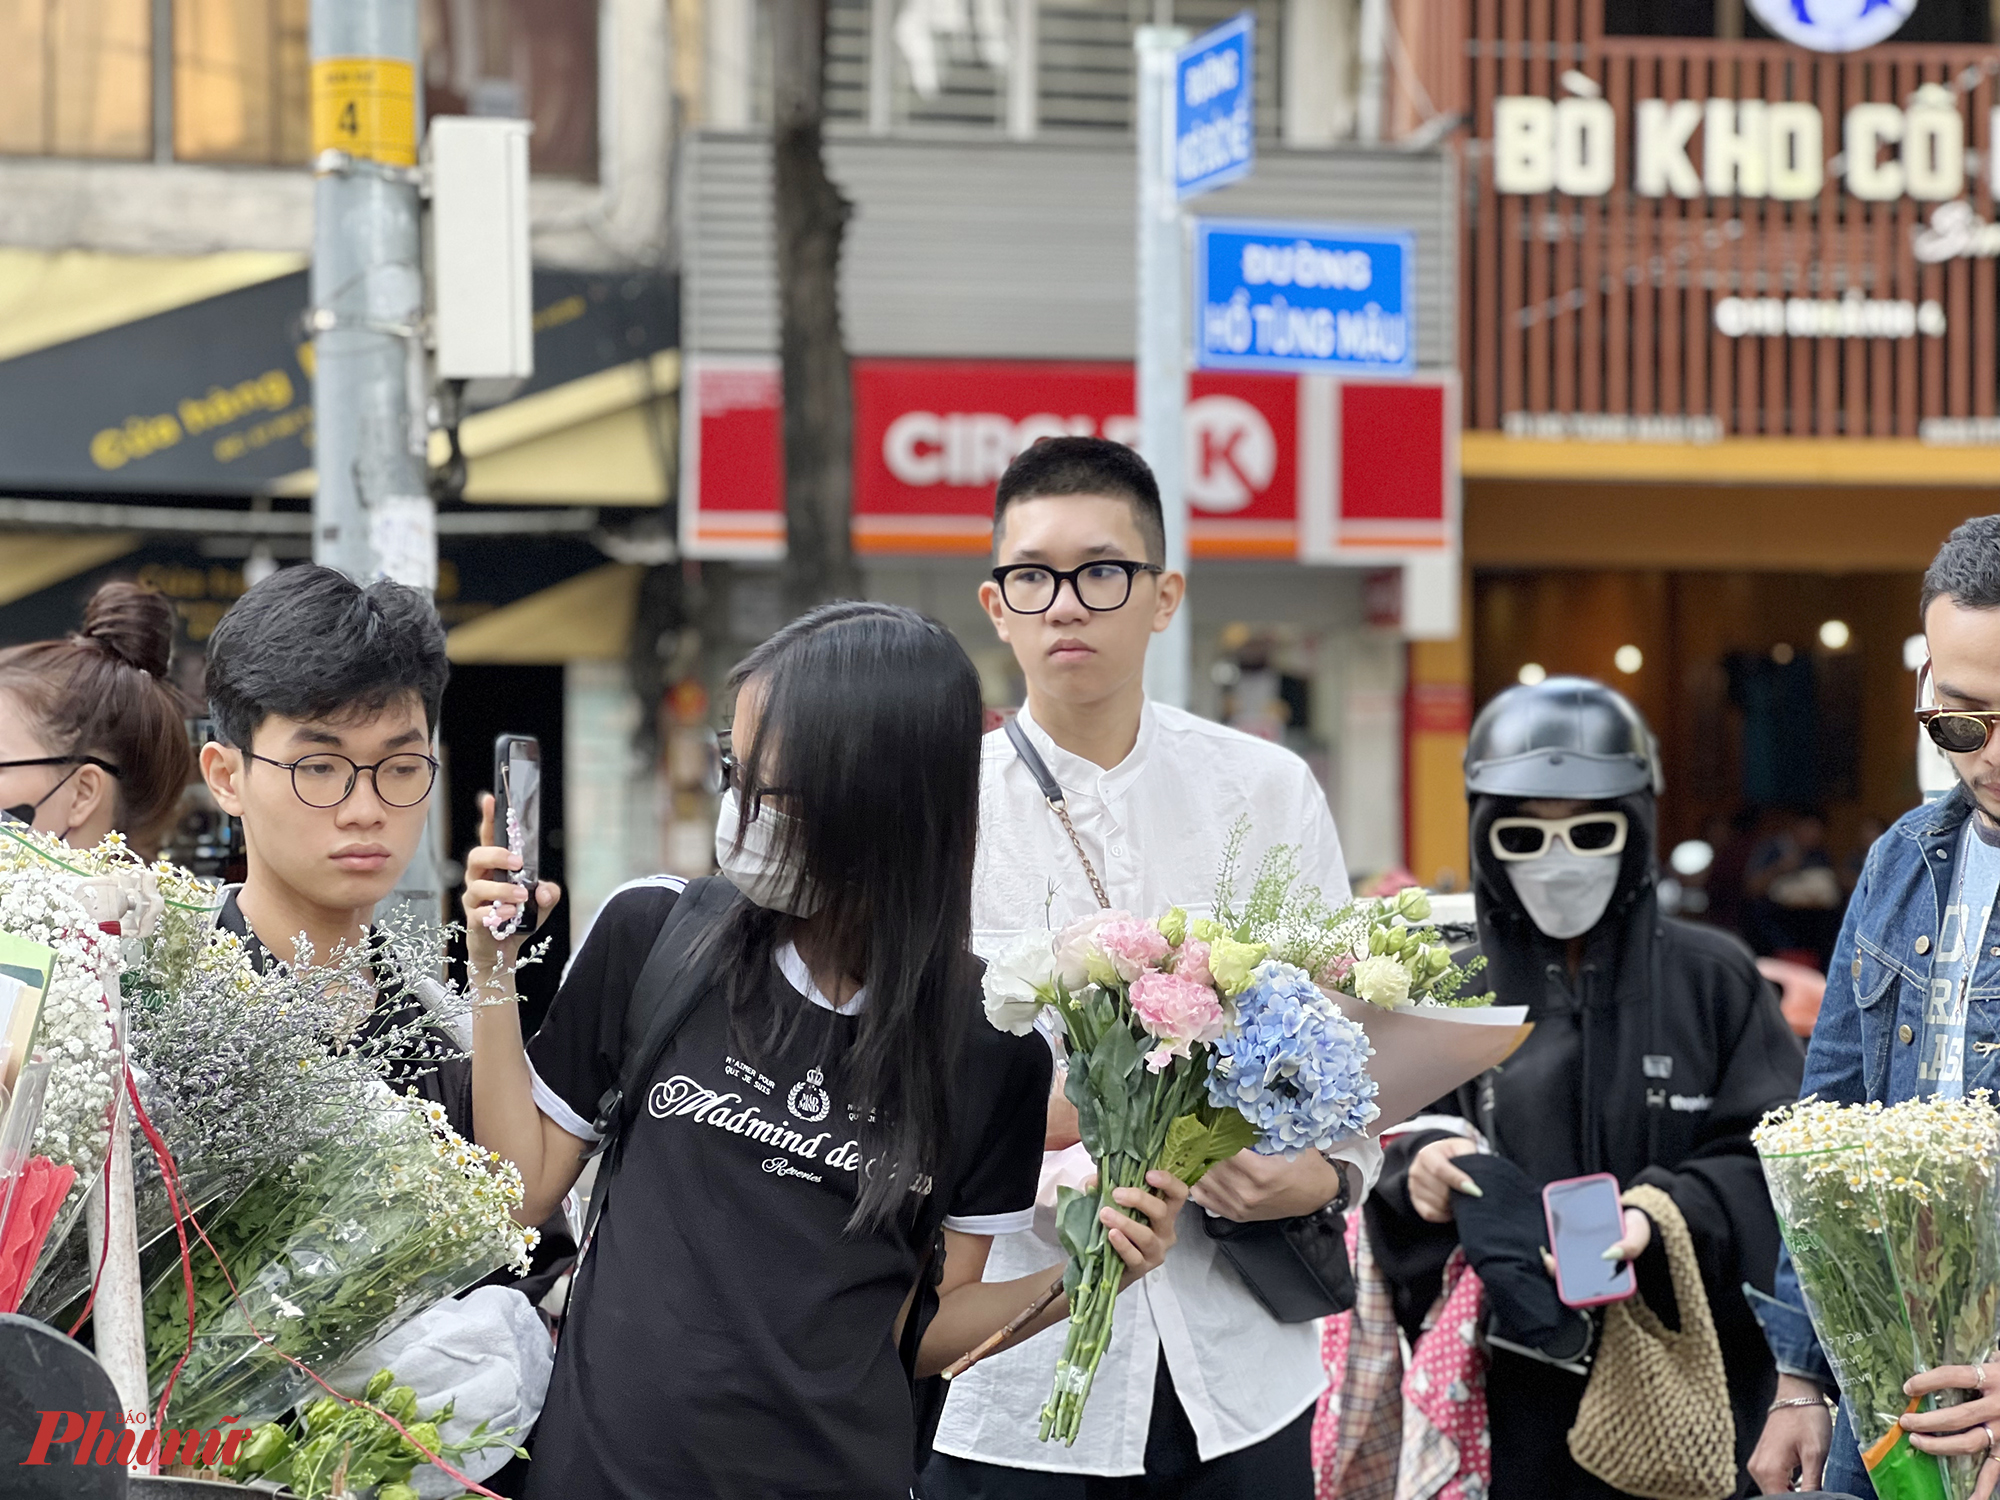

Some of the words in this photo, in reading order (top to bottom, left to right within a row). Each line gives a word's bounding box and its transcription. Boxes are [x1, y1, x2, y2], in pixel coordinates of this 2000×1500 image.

[338, 100, 359, 138] 4
[1495, 69, 1615, 196] BÒ
[1636, 98, 1823, 200] KHO
[1845, 82, 1965, 200] CÔ
[1242, 240, 1373, 291] ĐƯỜNG
[1252, 294, 1336, 359] TÙNG
[725, 1056, 757, 1077] M'AIMER
[758, 1073, 776, 1089] POUR
[725, 1065, 740, 1077] QUI
[741, 1073, 752, 1084] JE
[753, 1081, 771, 1096] SUIS
[648, 1075, 832, 1159] Madmind
